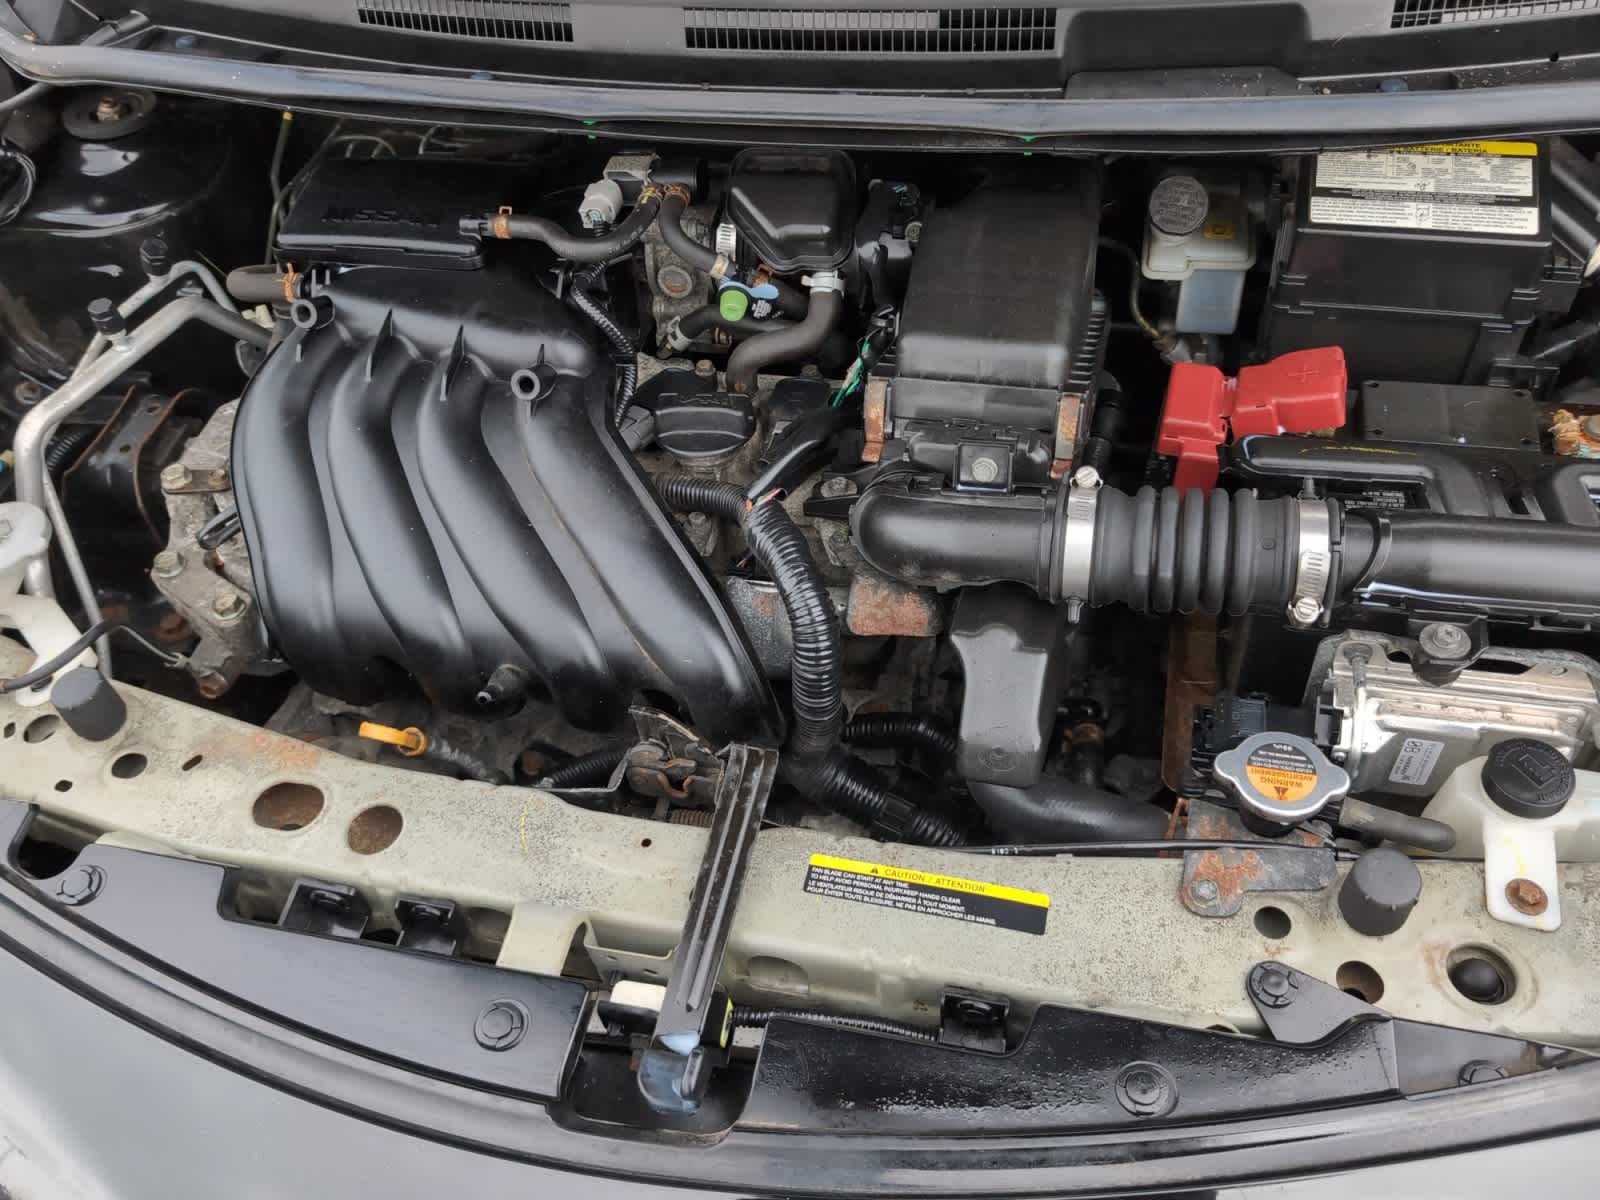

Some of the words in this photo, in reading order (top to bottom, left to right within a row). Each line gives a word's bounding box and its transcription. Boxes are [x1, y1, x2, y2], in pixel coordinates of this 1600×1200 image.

[1260, 776, 1303, 788] WARNING
[884, 868, 924, 881] CAUTION
[935, 877, 984, 892] ATTENTION
